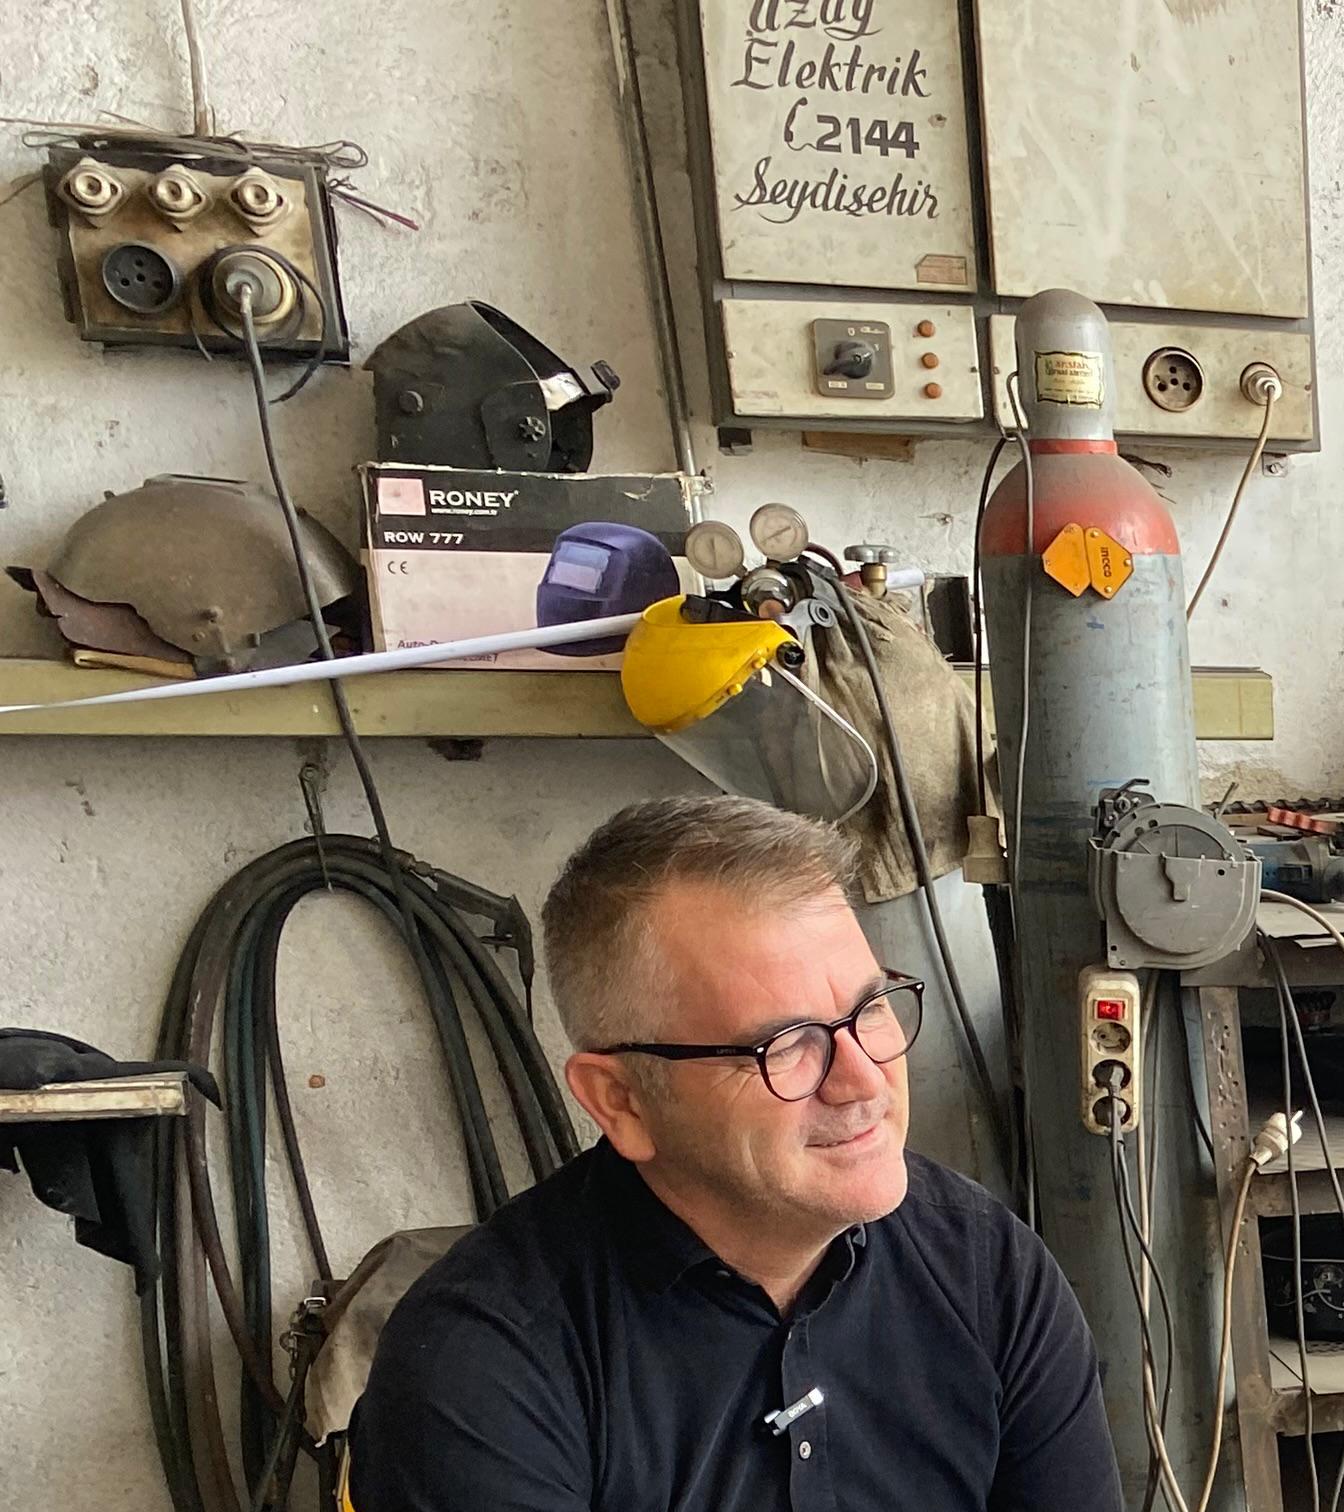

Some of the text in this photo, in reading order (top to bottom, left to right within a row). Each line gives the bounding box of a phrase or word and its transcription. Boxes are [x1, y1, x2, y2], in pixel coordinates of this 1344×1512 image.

[730, 31, 931, 97] Elektrik
[816, 114, 920, 158] 2144
[730, 156, 940, 223] Seydişehir
[429, 490, 515, 508] RONEY
[383, 531, 464, 545] ROW 777
